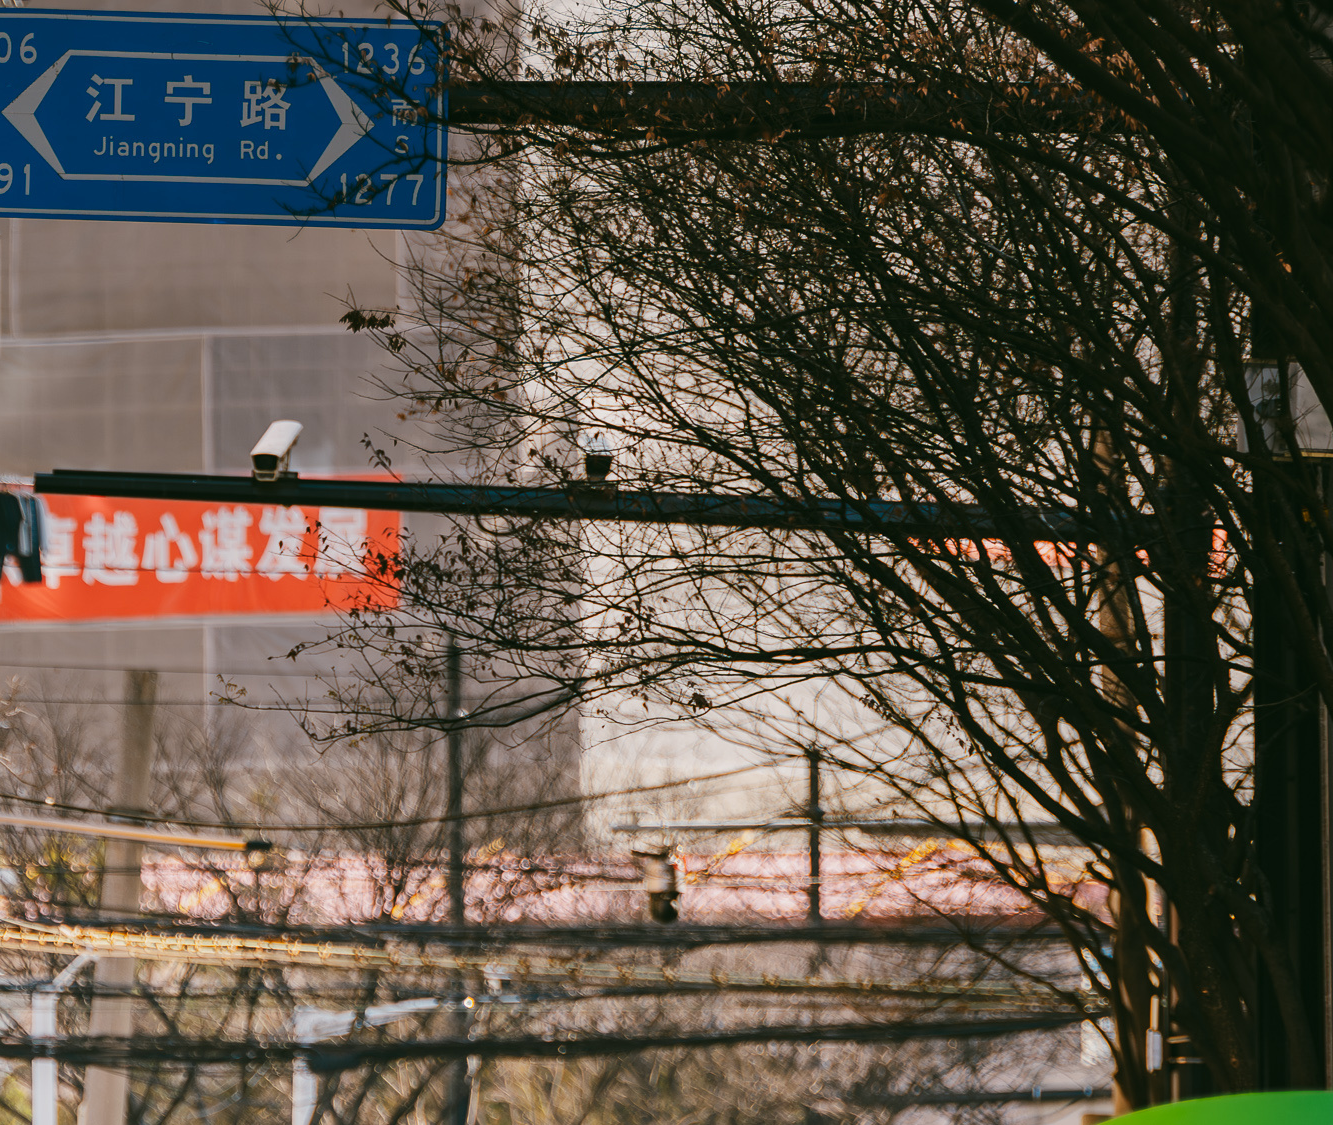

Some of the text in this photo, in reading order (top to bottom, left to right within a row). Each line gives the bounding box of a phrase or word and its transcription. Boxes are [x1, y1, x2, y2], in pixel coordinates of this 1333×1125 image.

[342, 41, 427, 76] 1236
[84, 74, 292, 131] 江宁路
[93, 136, 283, 165] Jiangning Rd.
[394, 135, 410, 155] S
[340, 172, 425, 207] 1277
[1, 505, 368, 591] 卓越心谋发展
